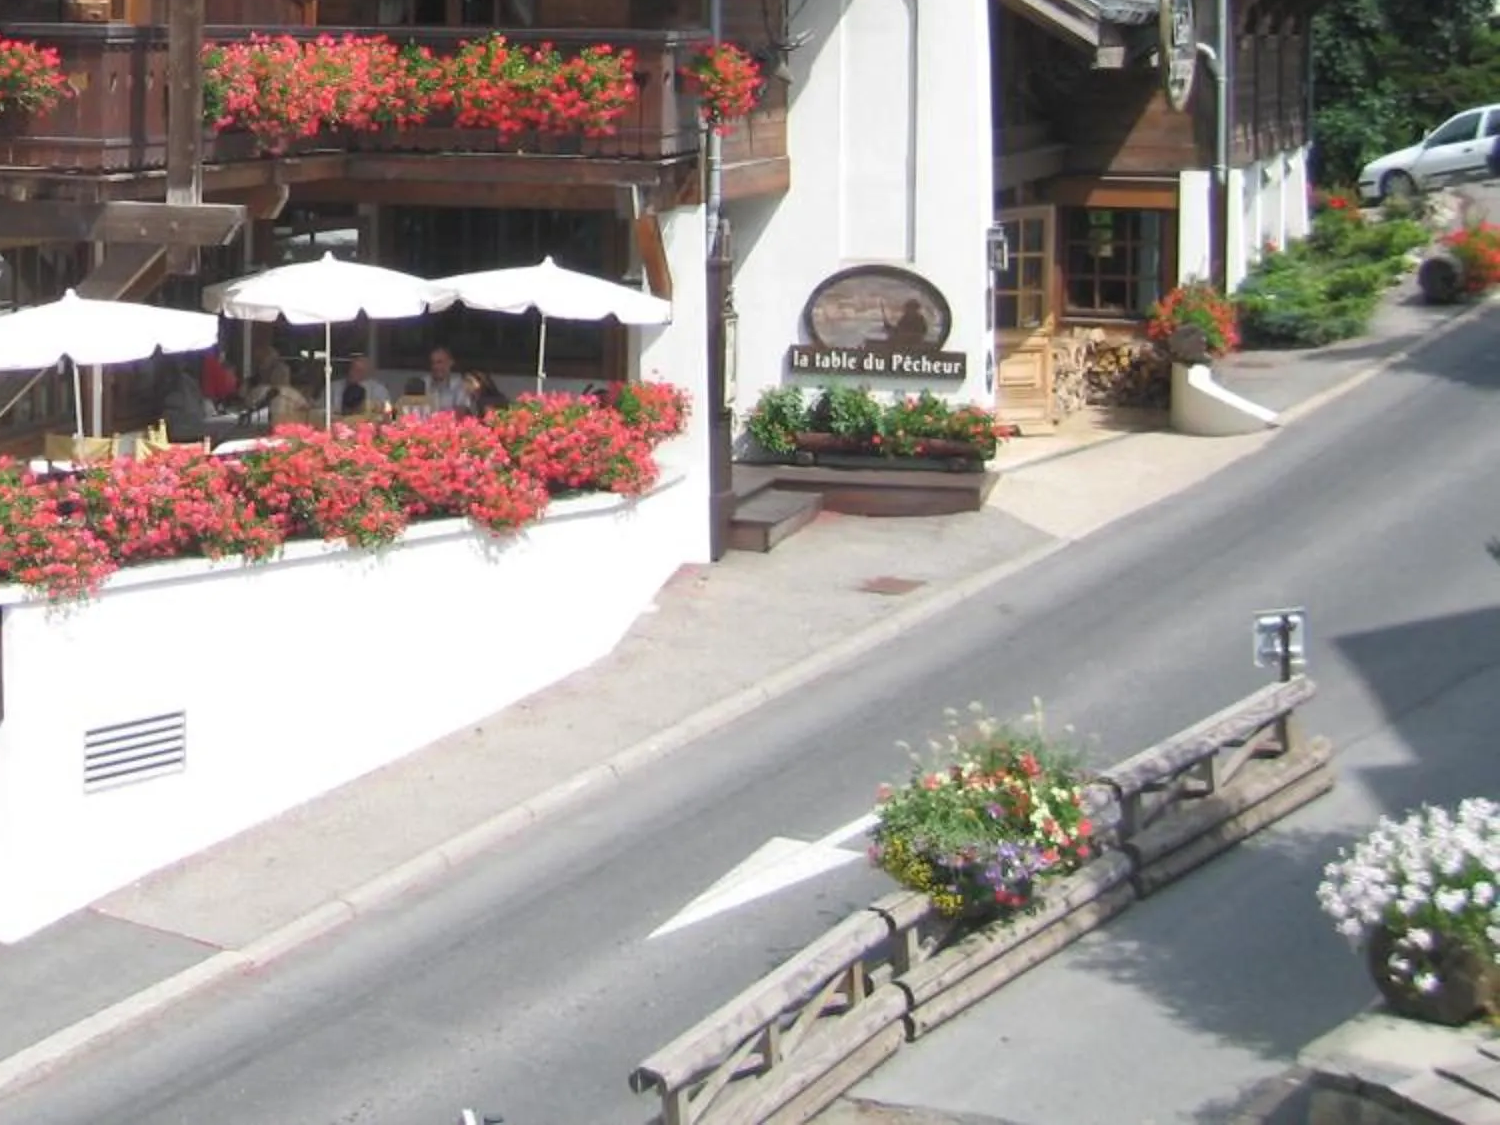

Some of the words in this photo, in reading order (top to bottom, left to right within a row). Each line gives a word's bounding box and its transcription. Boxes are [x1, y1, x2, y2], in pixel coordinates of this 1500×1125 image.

[794, 350, 809, 368] la
[815, 350, 857, 370] table
[863, 352, 885, 371] du
[892, 353, 961, 374] Pêcheur
